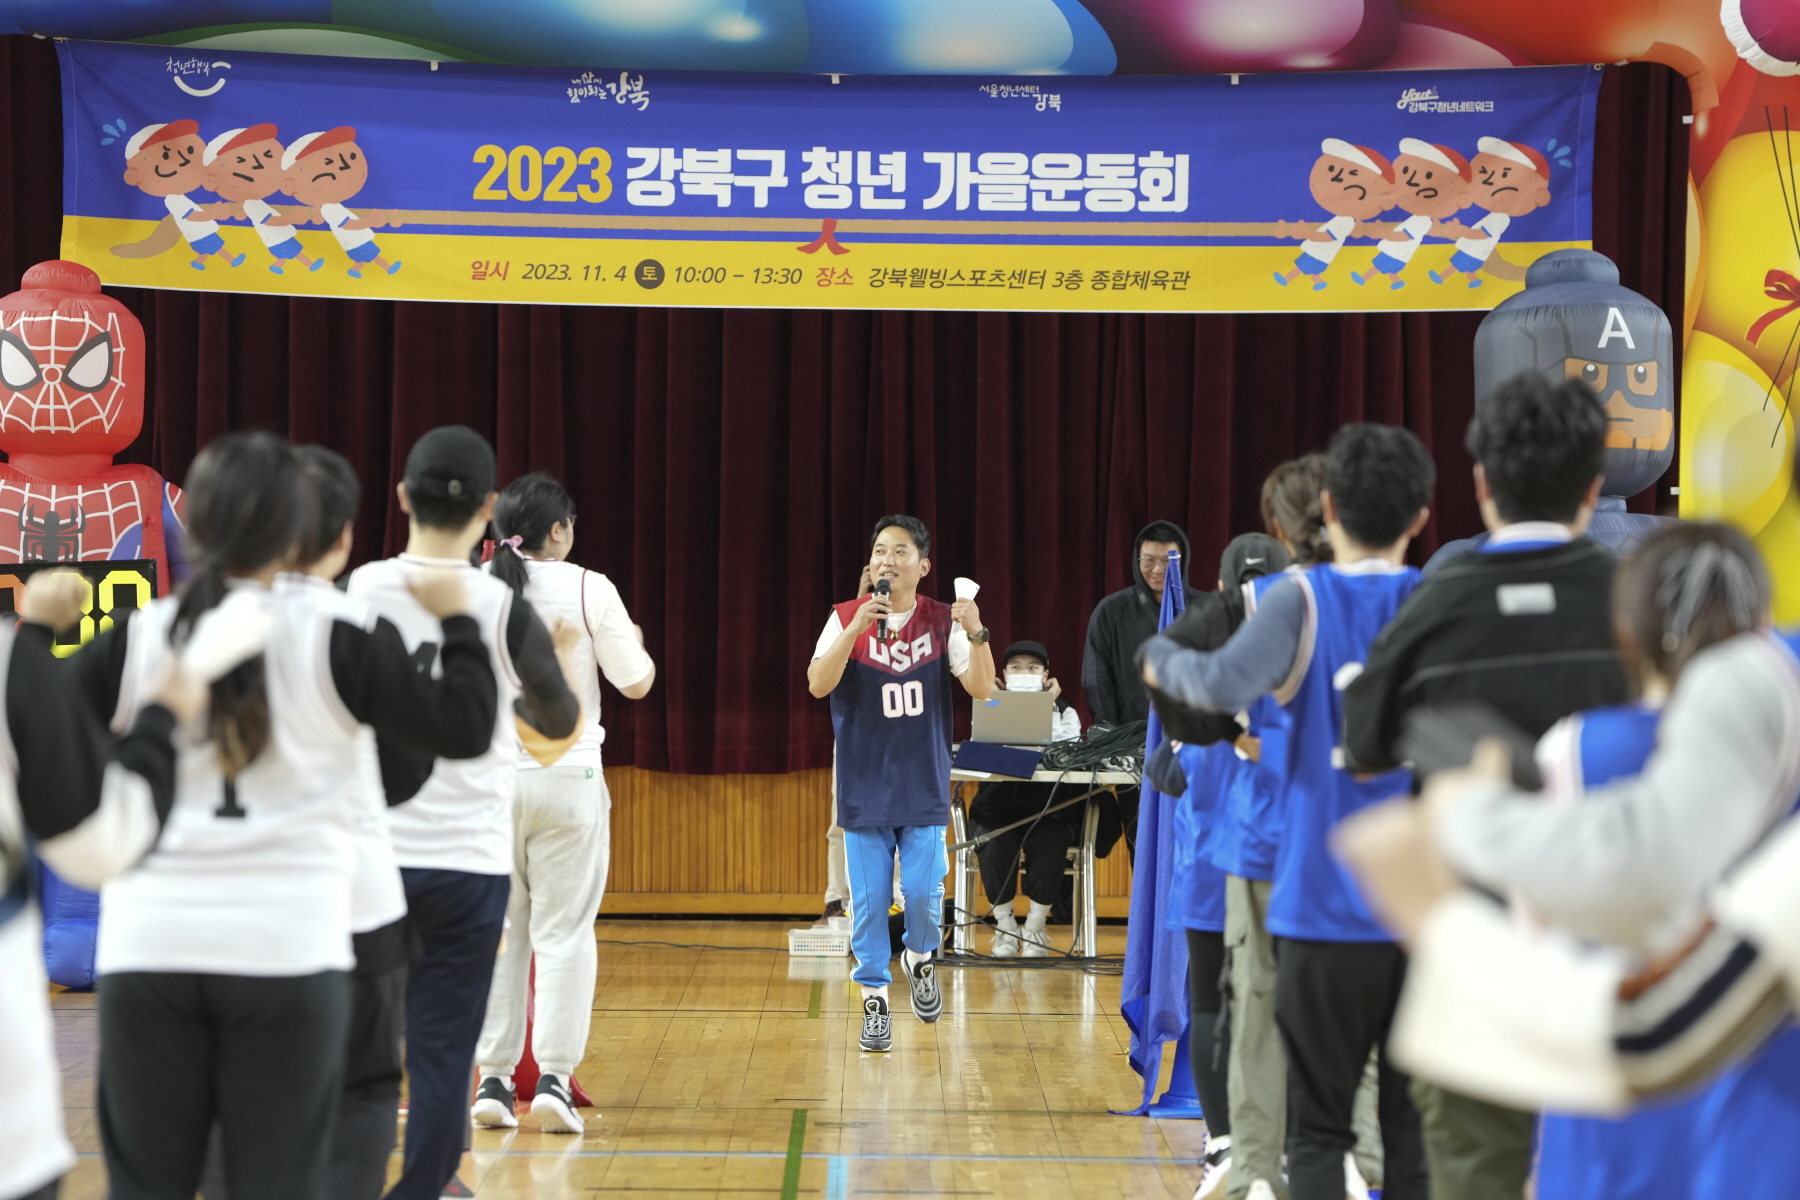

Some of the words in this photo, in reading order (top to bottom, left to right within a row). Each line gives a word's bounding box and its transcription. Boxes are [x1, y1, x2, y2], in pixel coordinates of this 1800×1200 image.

[606, 71, 650, 111] 강북
[979, 83, 1040, 98] 서울청년센터
[1032, 93, 1062, 112] 강북
[1408, 101, 1494, 113] 강북구청년네트워크
[473, 144, 613, 203] 2023
[626, 147, 789, 208] 강북구
[801, 146, 907, 210] 청년
[922, 150, 1190, 213] 가을운동회
[470, 260, 509, 281] 일시
[521, 263, 572, 281] 2023.
[582, 265, 606, 282] 11.
[614, 265, 627, 282] 4
[674, 266, 727, 284] 10:00
[753, 267, 803, 285] 13:30
[816, 267, 854, 287] 장소
[868, 267, 1047, 290] 강북웰빙스포츠센터
[1052, 269, 1084, 291] 3층
[1090, 270, 1191, 291] 종합체육관
[1597, 307, 1636, 349] A
[868, 632, 932, 673] USA
[881, 680, 924, 718] 00
